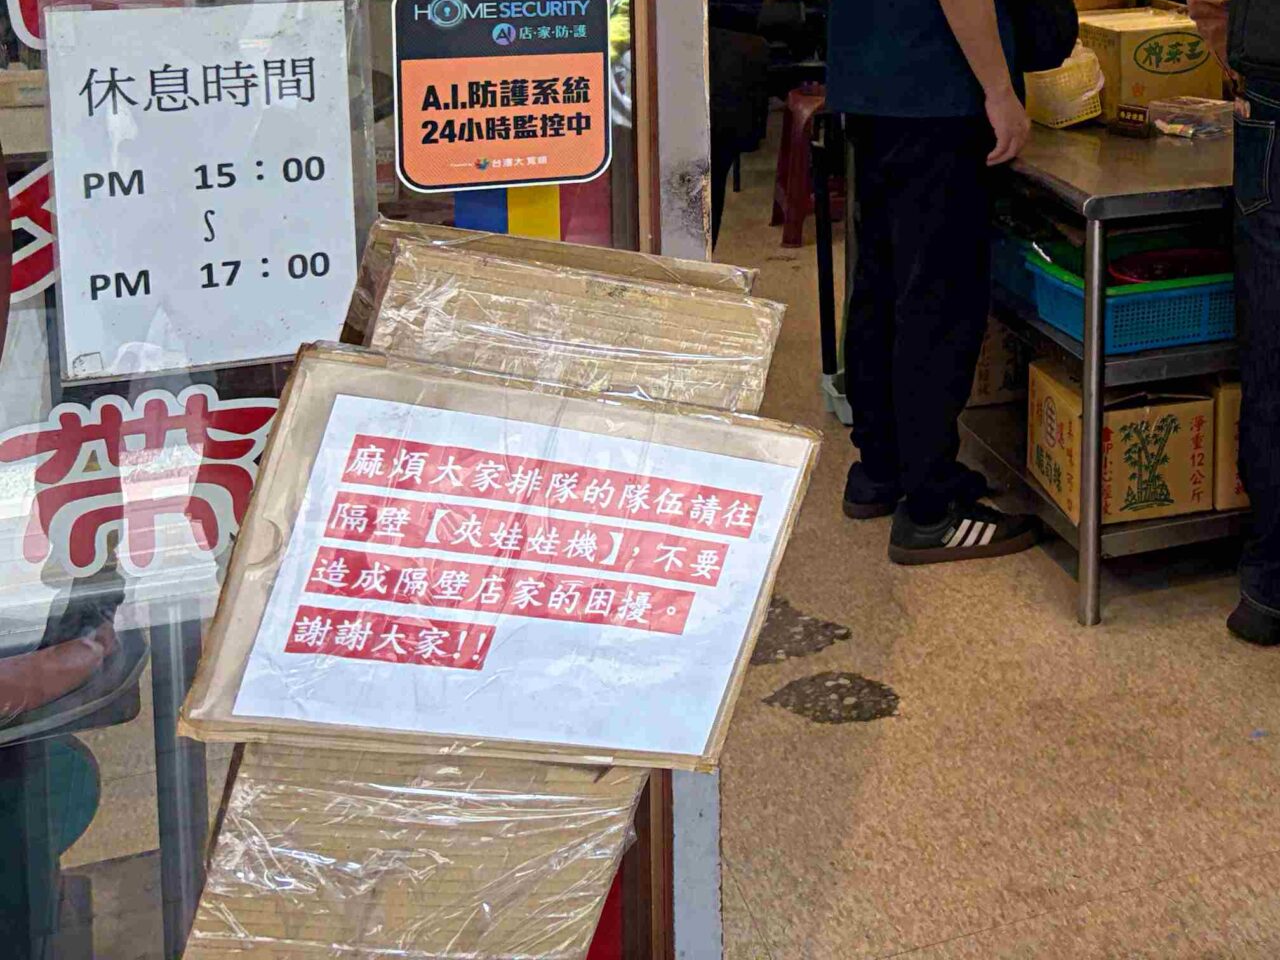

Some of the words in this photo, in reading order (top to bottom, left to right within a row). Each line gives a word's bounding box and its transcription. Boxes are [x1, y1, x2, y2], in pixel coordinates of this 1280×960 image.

[78, 56, 316, 117] 休息時間
[421, 76, 591, 112] A.I.防護系統
[421, 112, 592, 145] 24小時監控中
[83, 169, 145, 200] PM
[89, 269, 151, 301] PM
[346, 444, 754, 529] 麻煩大家排隊的隊伍請往
[311, 557, 676, 625] 造成隔壁店家的困擾。
[294, 614, 487, 662] 謝謝大家!!
